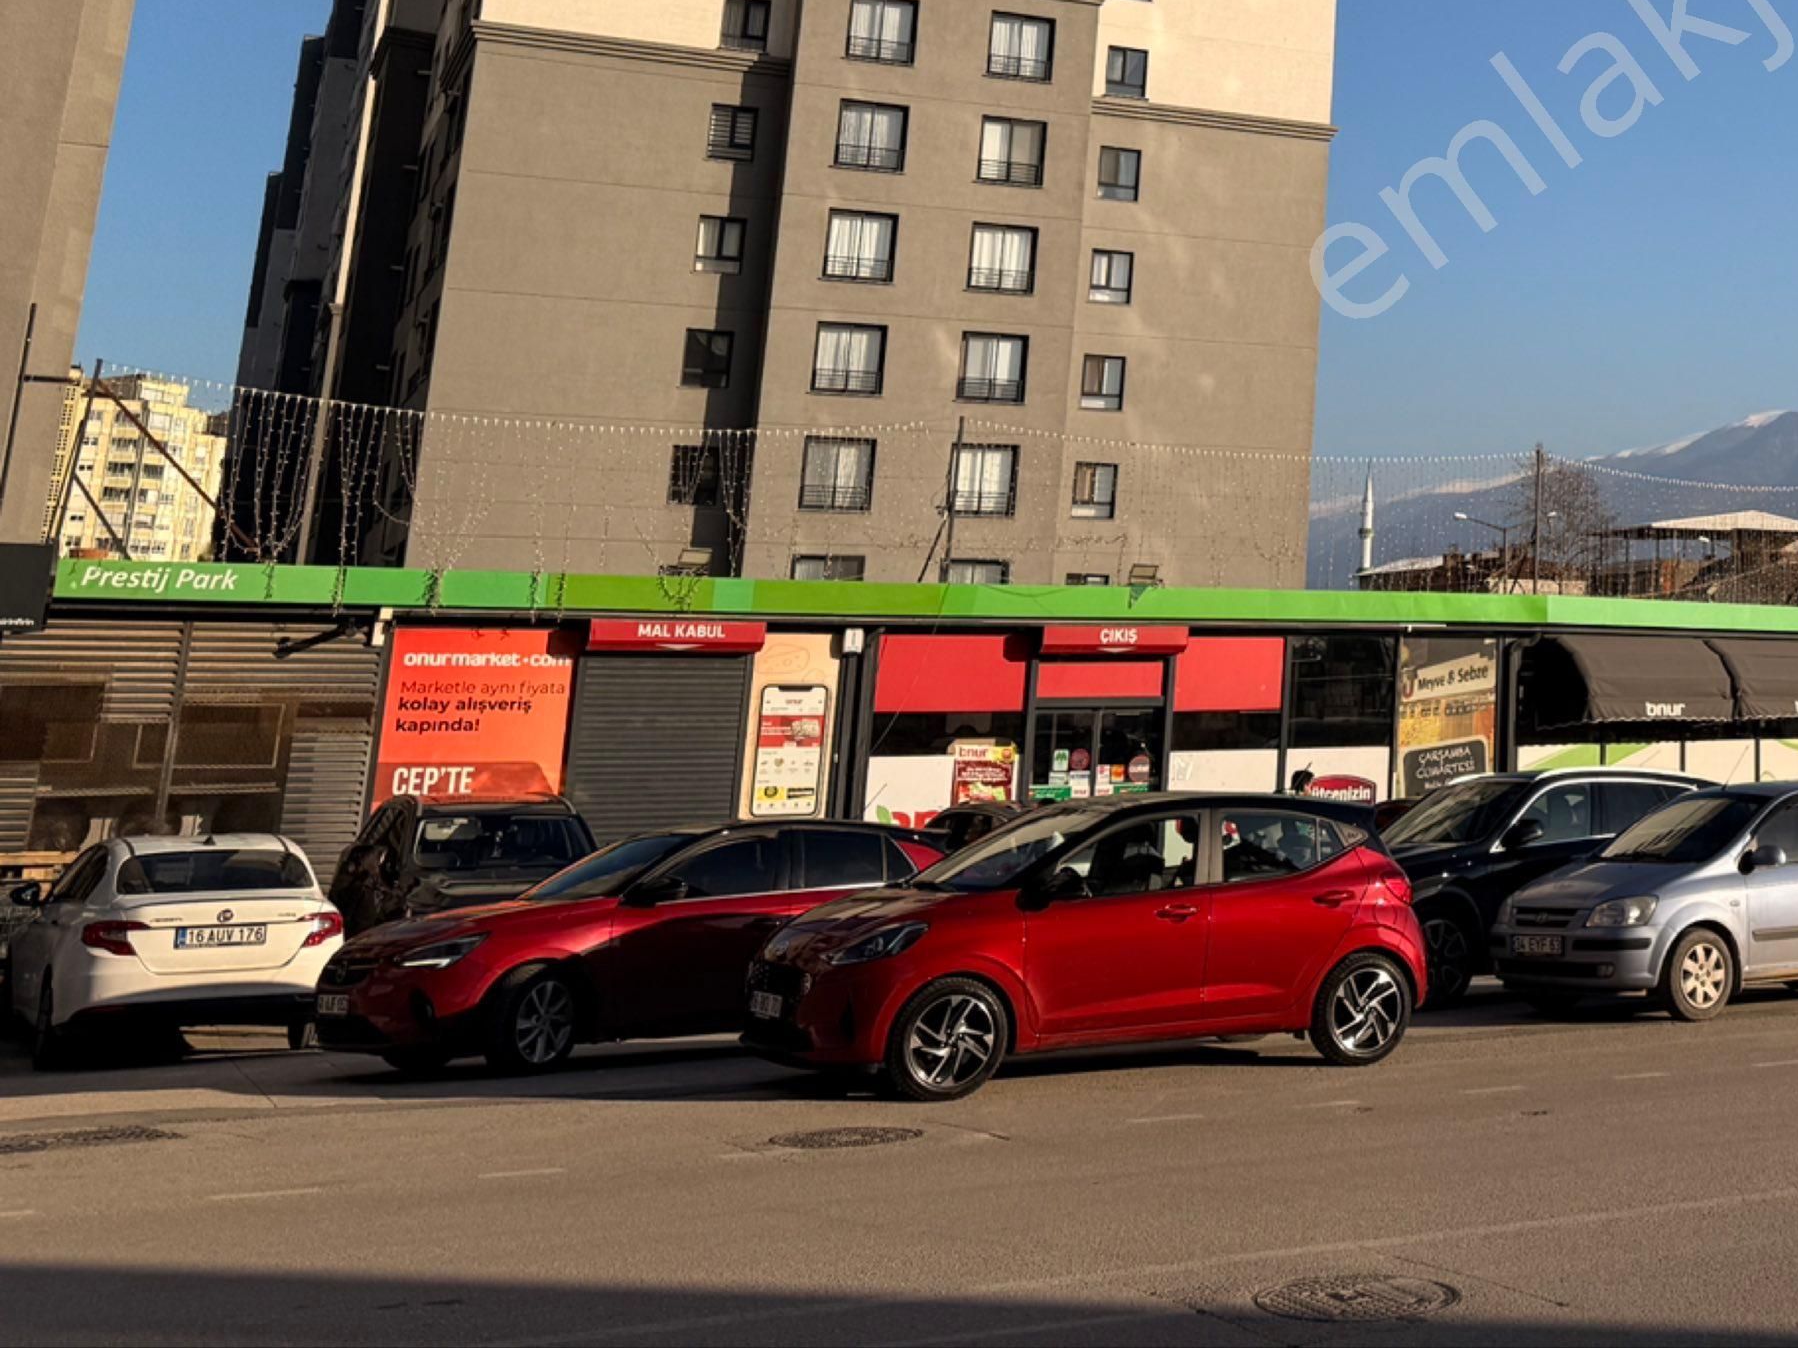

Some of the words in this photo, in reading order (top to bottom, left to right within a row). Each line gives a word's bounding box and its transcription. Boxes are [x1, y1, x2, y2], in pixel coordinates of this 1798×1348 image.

[81, 565, 172, 593] Prestij
[175, 568, 239, 590] Park
[638, 623, 671, 637] MAL
[674, 623, 726, 638] KABUL
[1417, 675, 1446, 692] Meyve
[1448, 669, 1456, 685] &
[1458, 664, 1489, 683] Sebze
[400, 680, 476, 695] Marketle
[480, 682, 515, 697] aynı
[519, 680, 565, 697] fiyata
[397, 696, 450, 714] kolay
[455, 696, 533, 714] alışveriş
[395, 718, 480, 735] kapında!
[392, 765, 476, 796] CEP'TE
[188, 930, 204, 943] 16
[207, 927, 235, 942] AUV
[239, 926, 263, 942] 176
